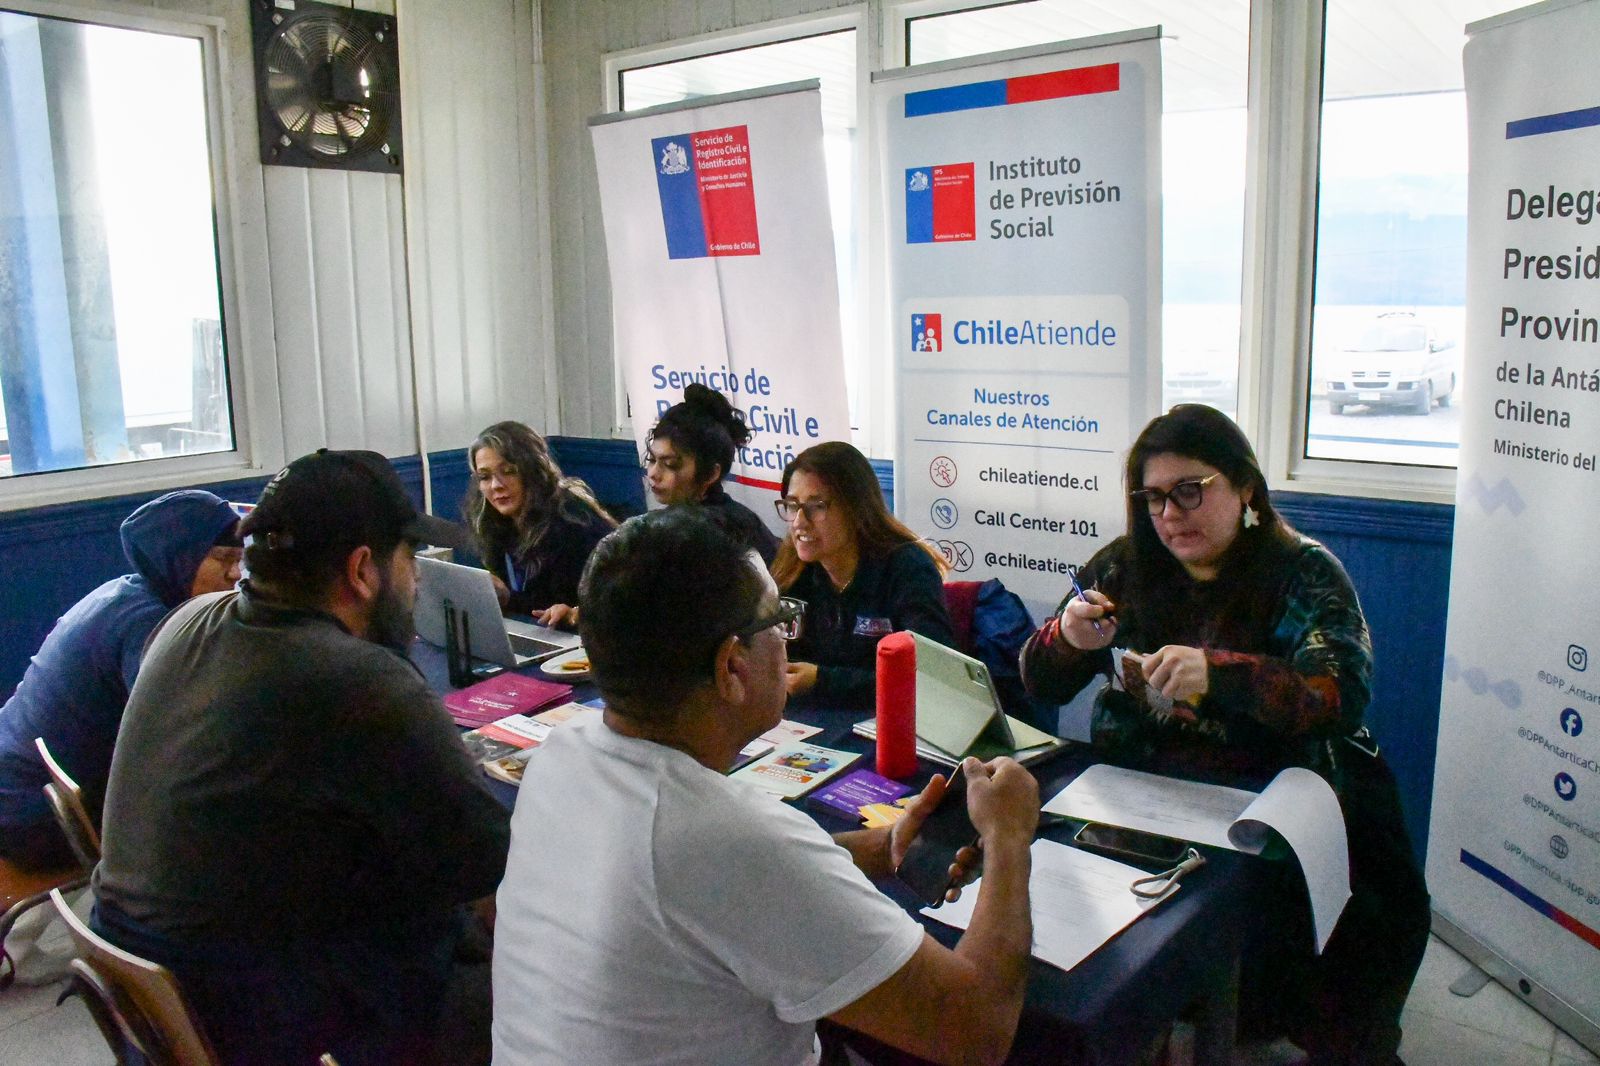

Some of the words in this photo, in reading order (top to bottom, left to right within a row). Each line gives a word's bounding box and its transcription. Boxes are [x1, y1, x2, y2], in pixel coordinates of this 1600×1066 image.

[695, 136, 723, 147] Servicio
[724, 134, 733, 142] de
[696, 147, 724, 159] Registro
[725, 144, 742, 154] Civil
[698, 156, 747, 169] Identificación
[990, 155, 1081, 181] Instituto
[989, 189, 1014, 211] de
[1022, 180, 1121, 208] Previsión
[1507, 185, 1600, 225] Deleg
[990, 215, 1054, 239] Social
[953, 319, 1116, 346] ChileAtiende
[1500, 307, 1598, 343] Provin
[652, 364, 739, 392] Servicio
[745, 368, 770, 395] de
[1496, 361, 1519, 384] de
[1527, 363, 1545, 386] la
[1551, 366, 1600, 392] Antá
[974, 388, 1050, 406] Nuestros
[750, 405, 799, 436] Civil
[805, 416, 819, 438] e
[927, 410, 991, 427] Canales
[996, 412, 1017, 428] de
[1022, 413, 1098, 433] Atención
[1494, 399, 1571, 428] Chilena
[1494, 439, 1569, 466] Ministerio
[1573, 452, 1596, 471] del
[979, 467, 1098, 491] chileatiende.cl
[975, 510, 1005, 527] Call
[1010, 513, 1065, 533] Center
[1070, 519, 1099, 537] 101
